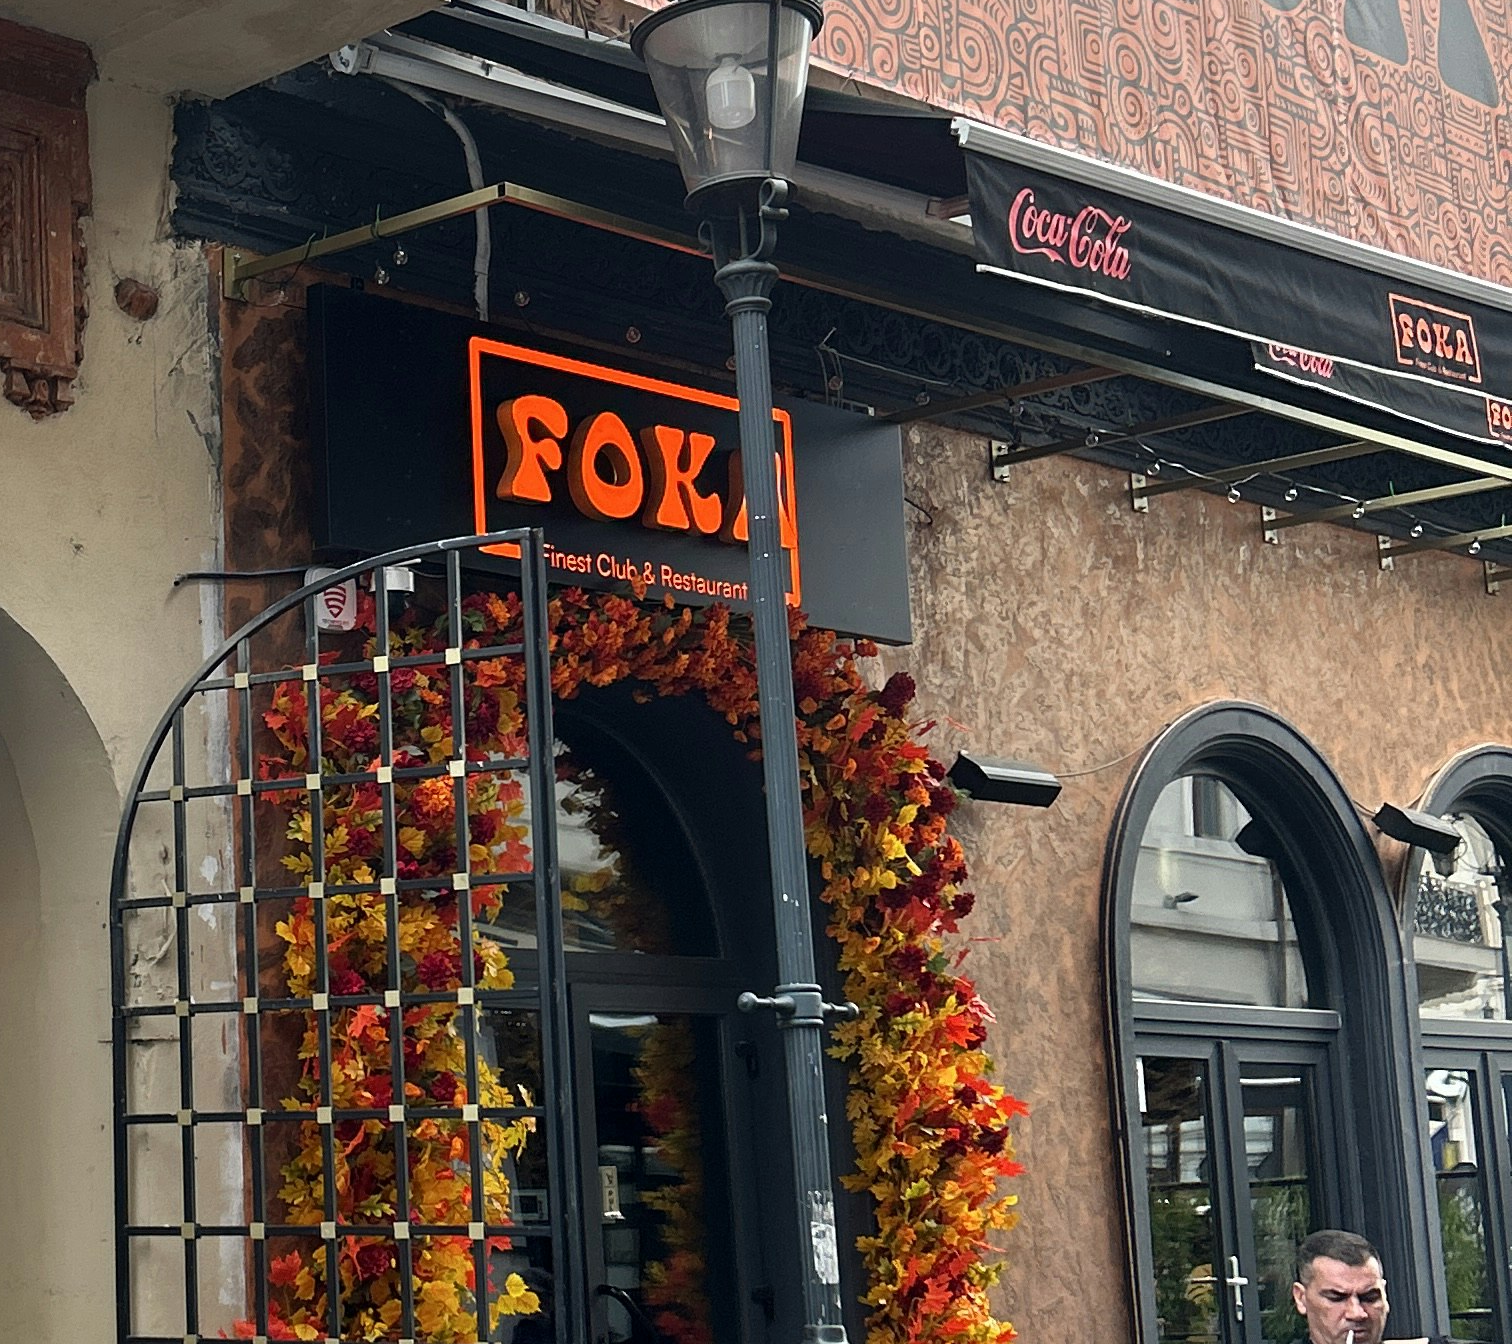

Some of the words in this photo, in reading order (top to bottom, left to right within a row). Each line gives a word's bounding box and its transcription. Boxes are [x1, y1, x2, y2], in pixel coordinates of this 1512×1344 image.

[1008, 187, 1132, 281] Coca-Cola
[1398, 313, 1474, 365] FOKA
[1491, 402, 1512, 430] FO
[597, 552, 638, 582] Club
[643, 562, 656, 585] &
[661, 567, 748, 601] Restaurant
